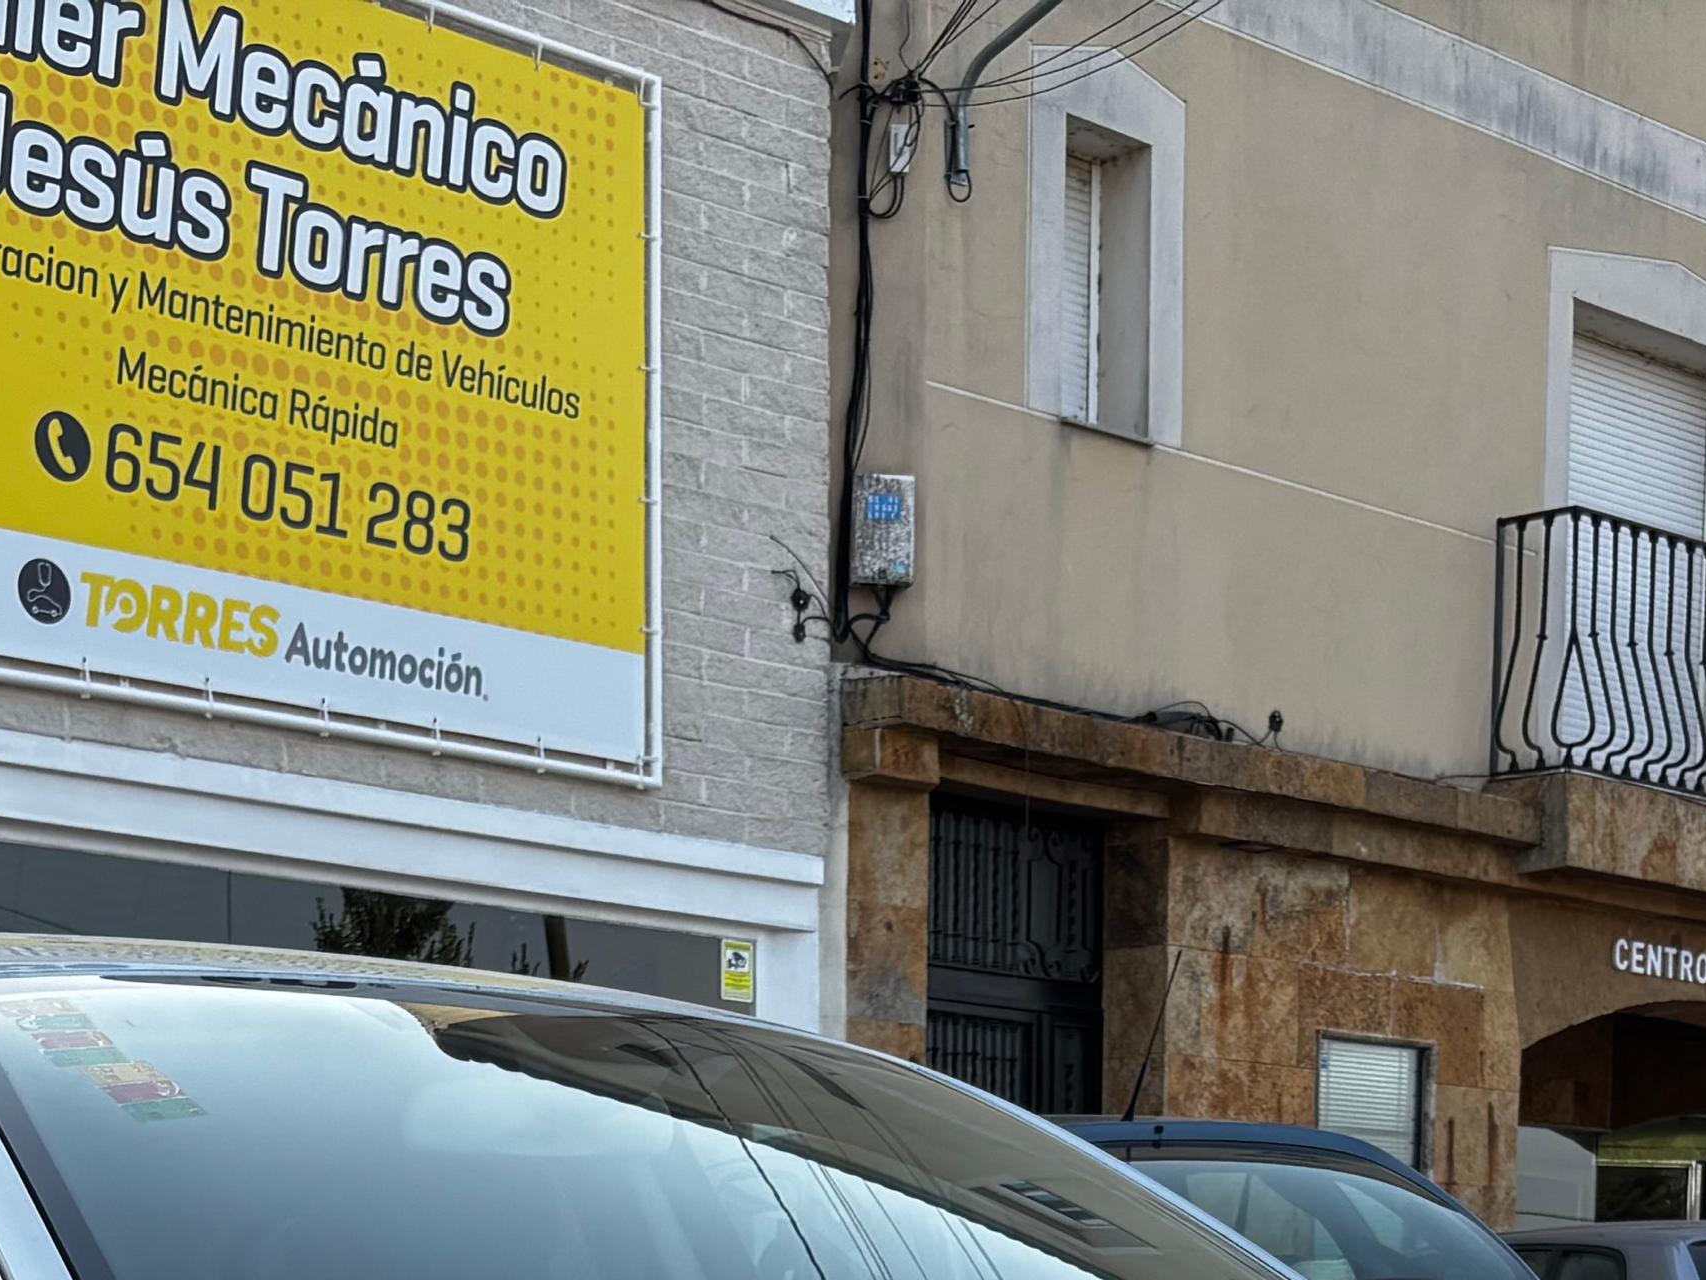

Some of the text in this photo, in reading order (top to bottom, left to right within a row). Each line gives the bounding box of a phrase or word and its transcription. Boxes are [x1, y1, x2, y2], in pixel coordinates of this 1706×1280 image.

[159, 0, 561, 211] Mecánico
[252, 167, 508, 333] Torres
[108, 273, 129, 314] y
[137, 272, 386, 371] Mantenimiento
[395, 345, 433, 383] de
[441, 348, 581, 420] Vehículos
[116, 347, 399, 448] Mecánica Rápida
[105, 423, 472, 562] 654 051 283
[80, 571, 282, 658] TORRES
